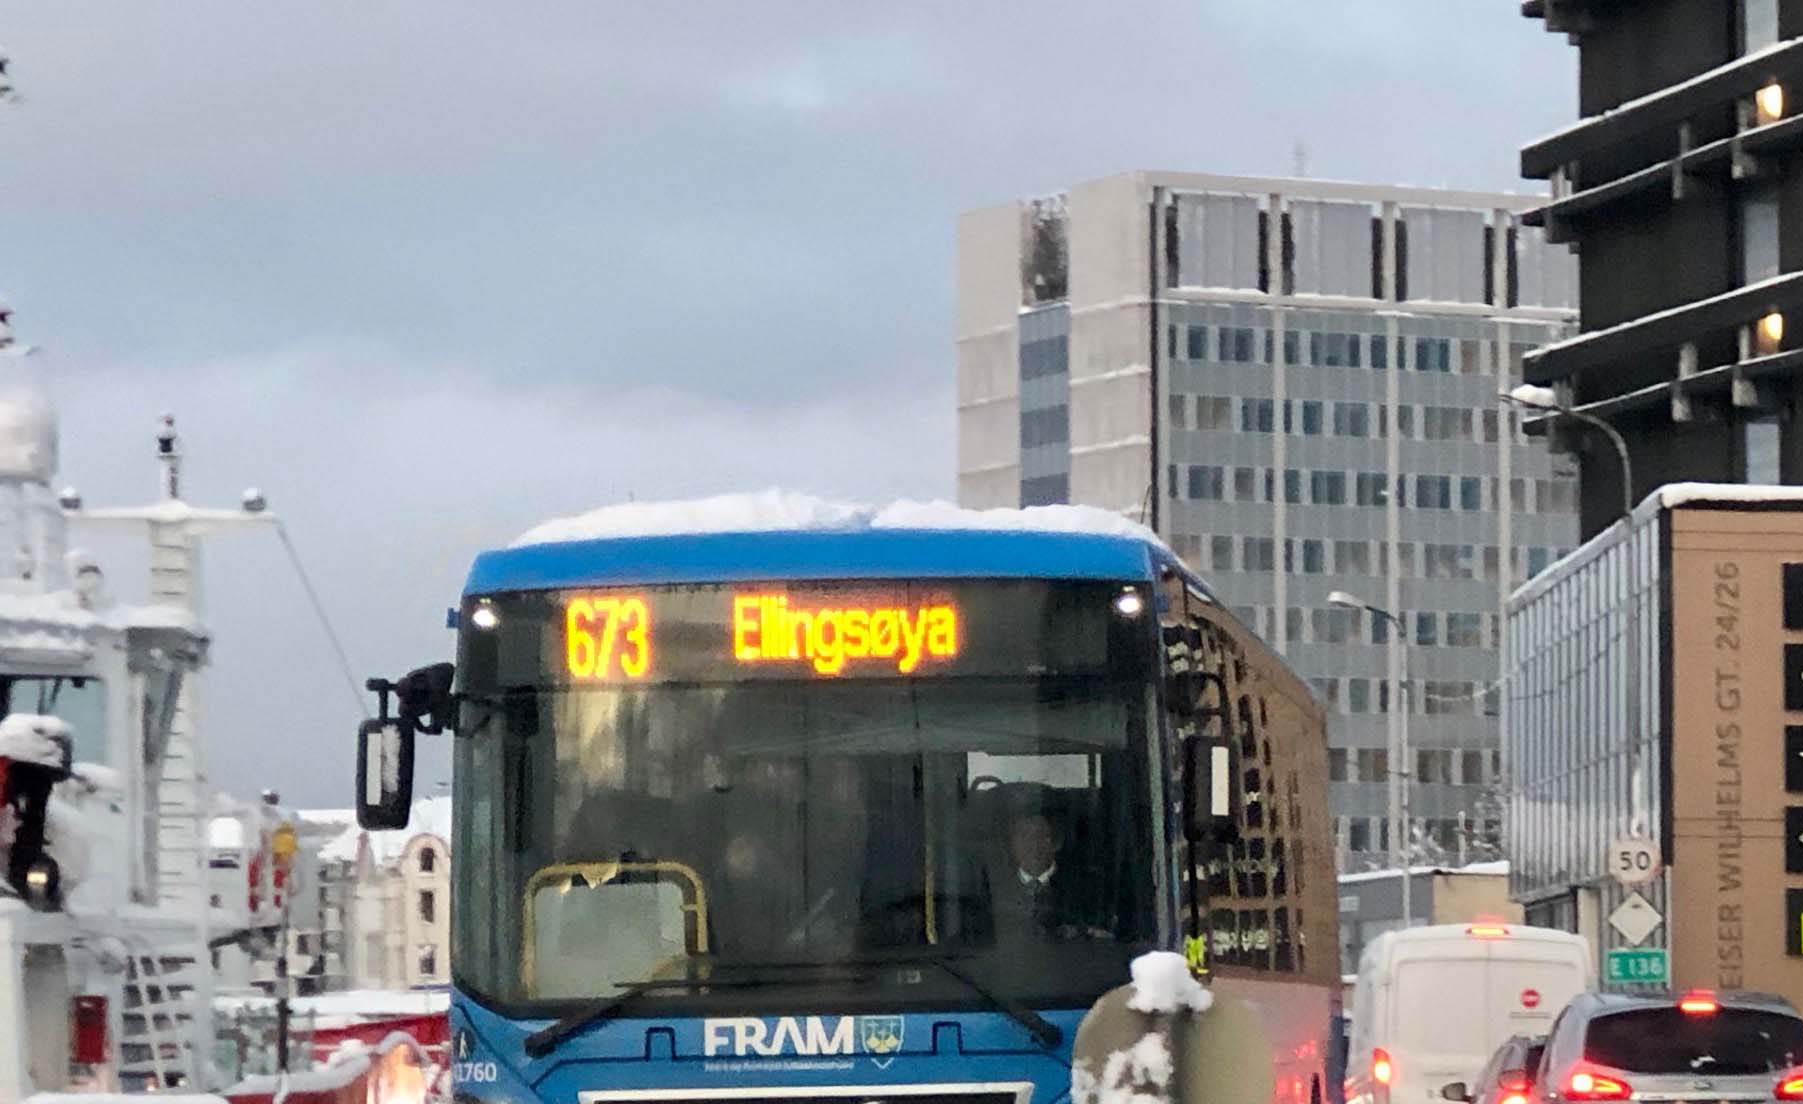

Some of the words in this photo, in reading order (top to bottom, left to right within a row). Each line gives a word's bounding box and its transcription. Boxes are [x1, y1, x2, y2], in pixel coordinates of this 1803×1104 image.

[566, 597, 650, 678] 673
[733, 595, 957, 673] Ellingsøya
[1714, 561, 1741, 651] 24/26
[1714, 658, 1742, 713] GT.
[1715, 722, 1743, 893] WILHELMS
[1619, 850, 1651, 871] 50
[1609, 957, 1621, 977] E
[1628, 957, 1664, 977] 136
[1717, 902, 1743, 989] EISER
[704, 1015, 855, 1056] FRAM
